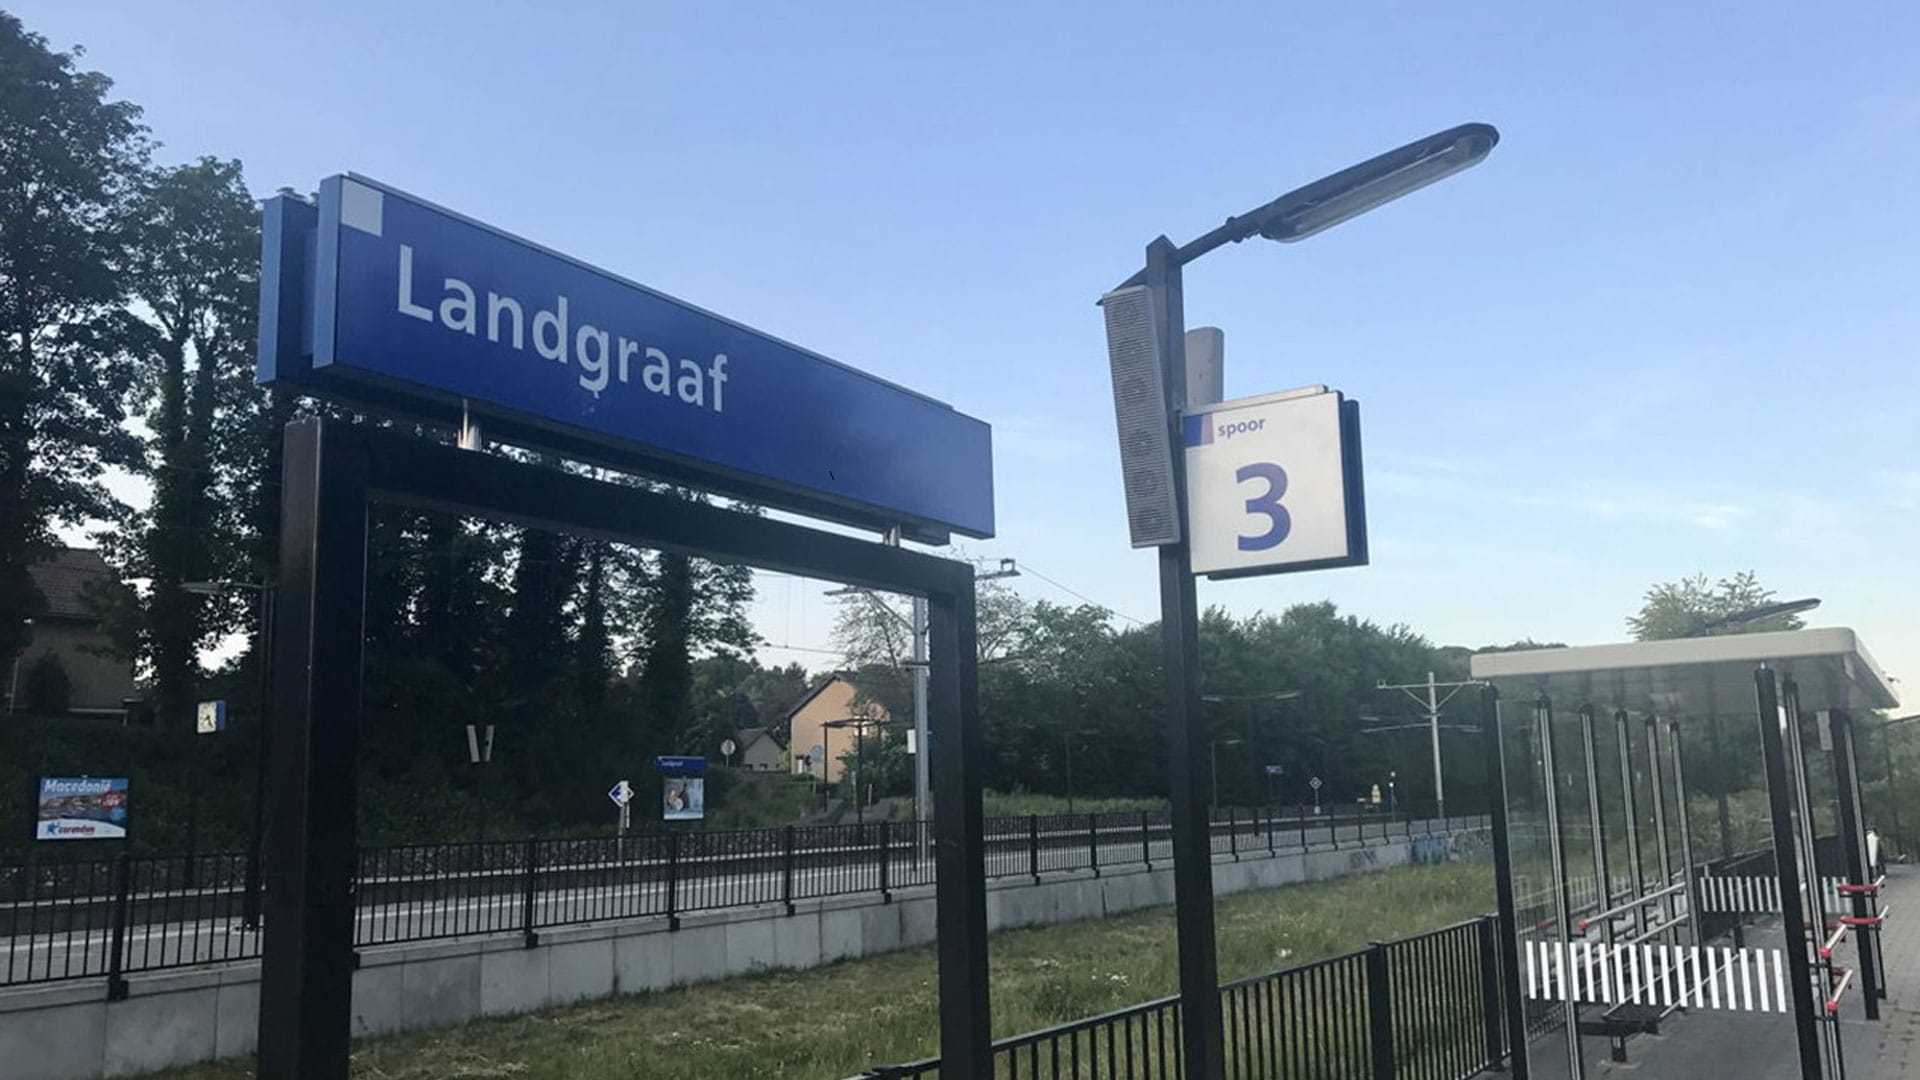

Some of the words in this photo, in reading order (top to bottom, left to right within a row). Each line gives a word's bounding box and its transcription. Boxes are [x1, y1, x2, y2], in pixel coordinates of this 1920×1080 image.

[397, 244, 728, 412] Landgraaf
[1218, 418, 1266, 438] spoor
[1236, 462, 1292, 551] 3
